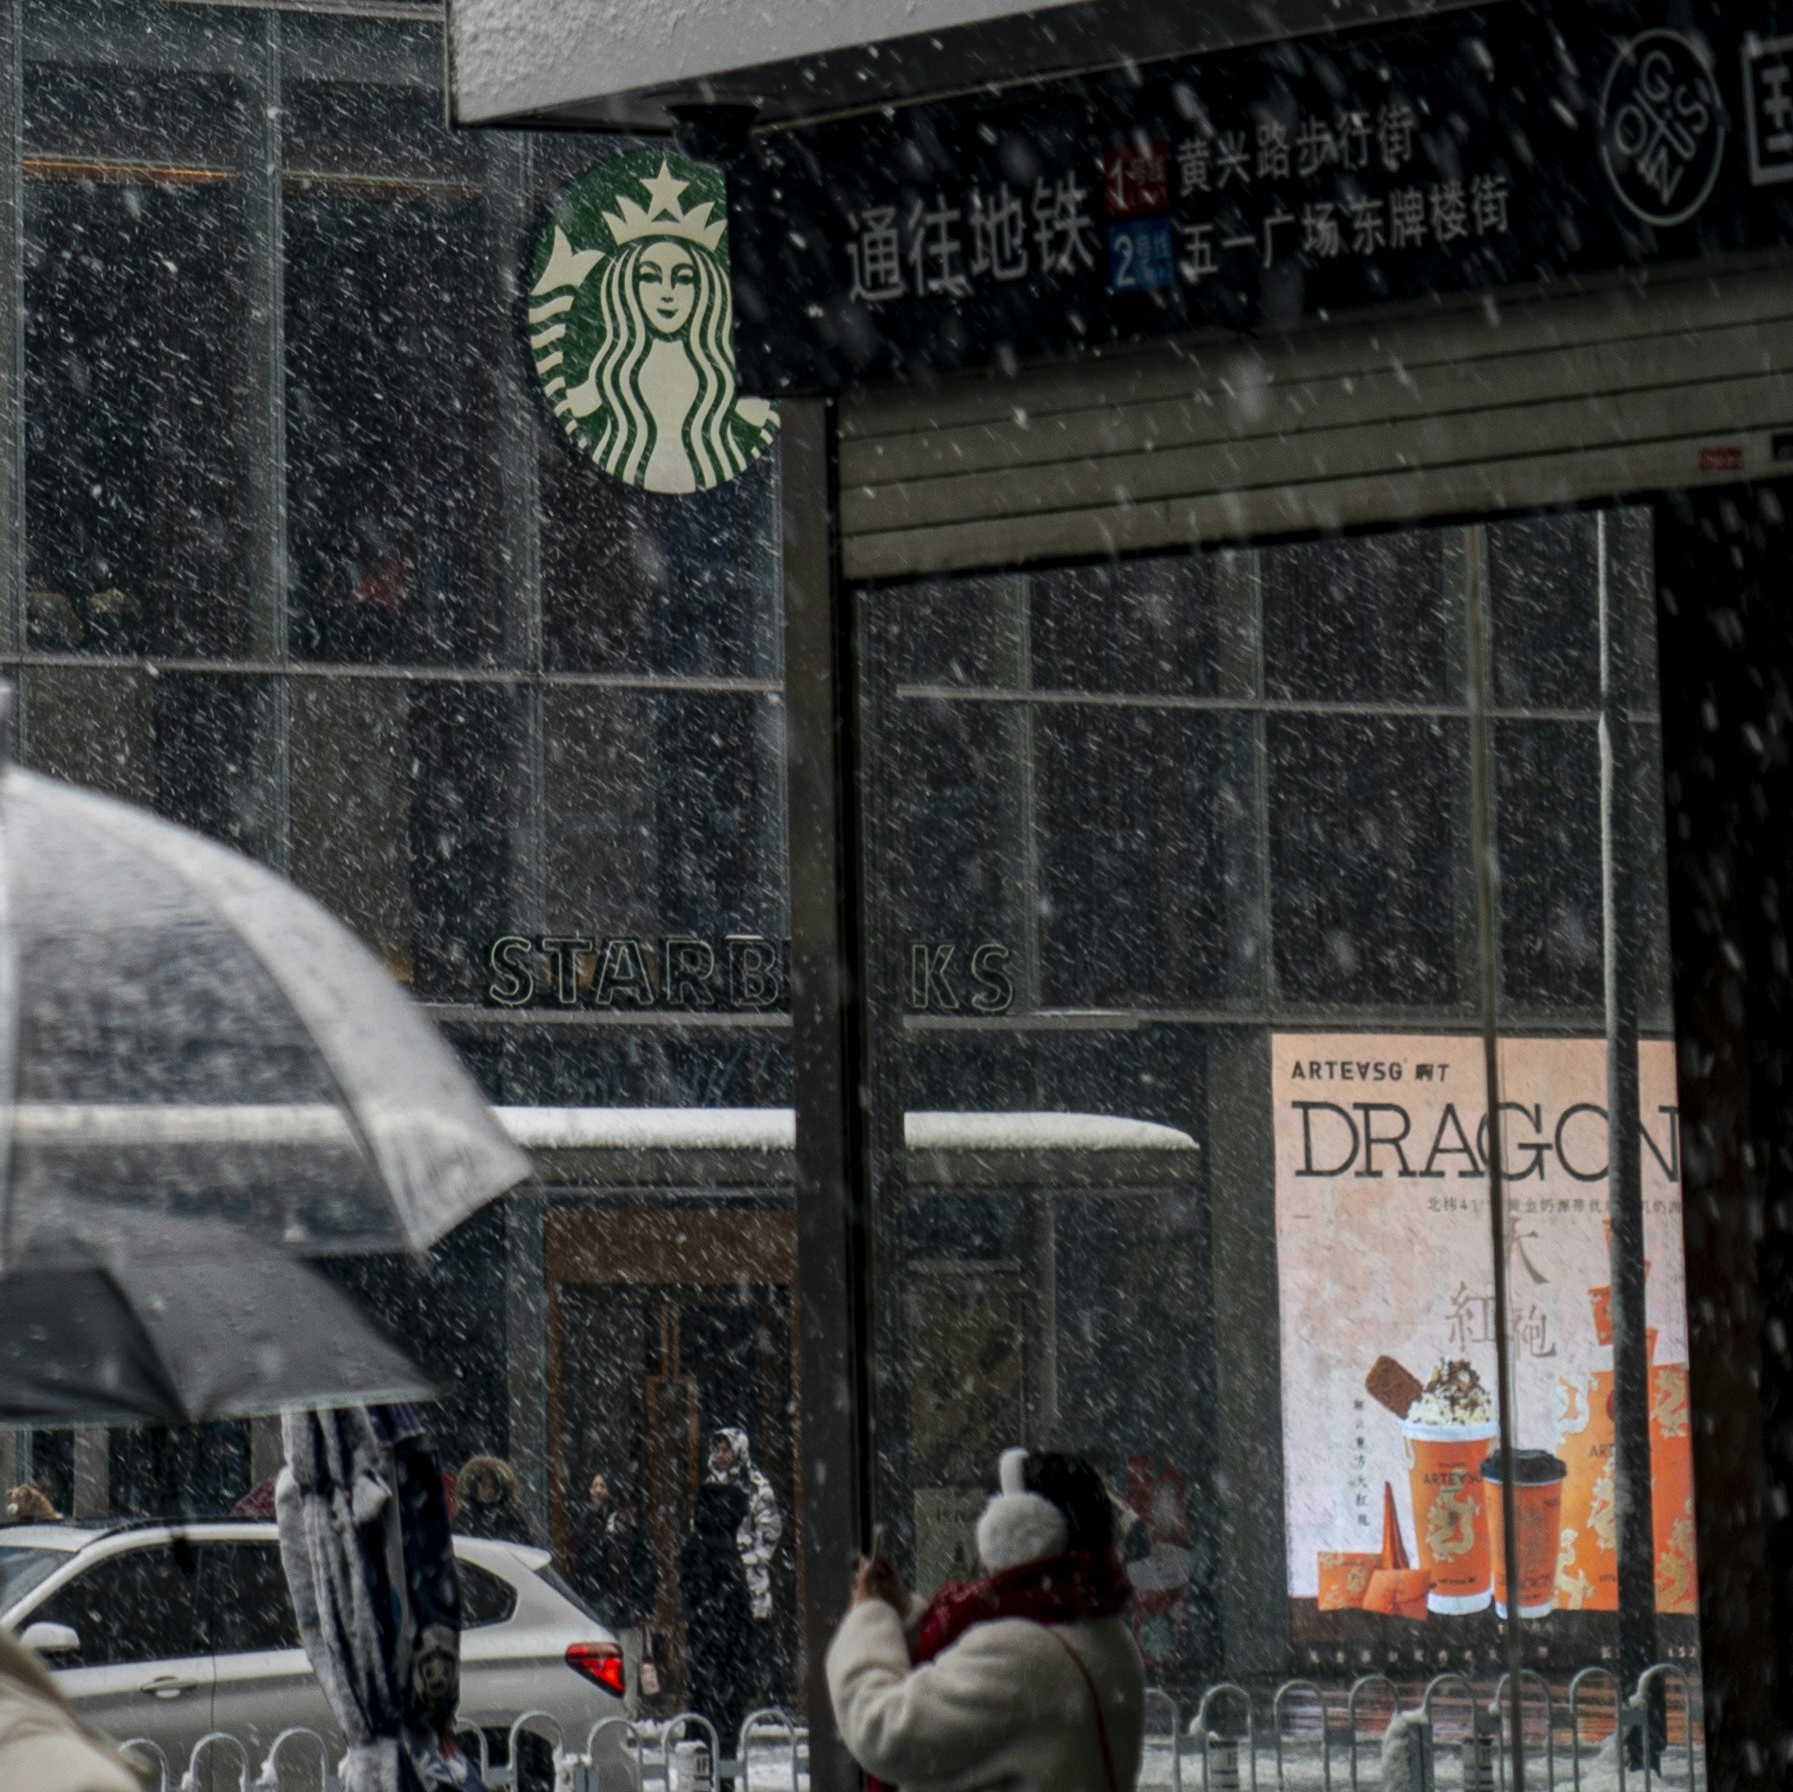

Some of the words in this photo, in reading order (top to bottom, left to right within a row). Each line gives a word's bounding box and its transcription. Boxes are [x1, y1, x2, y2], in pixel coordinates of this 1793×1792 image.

[1177, 103, 1414, 197] 黄兴路步行街
[846, 173, 1094, 304] 通往地铁
[489, 935, 1014, 1012] STARBKS
